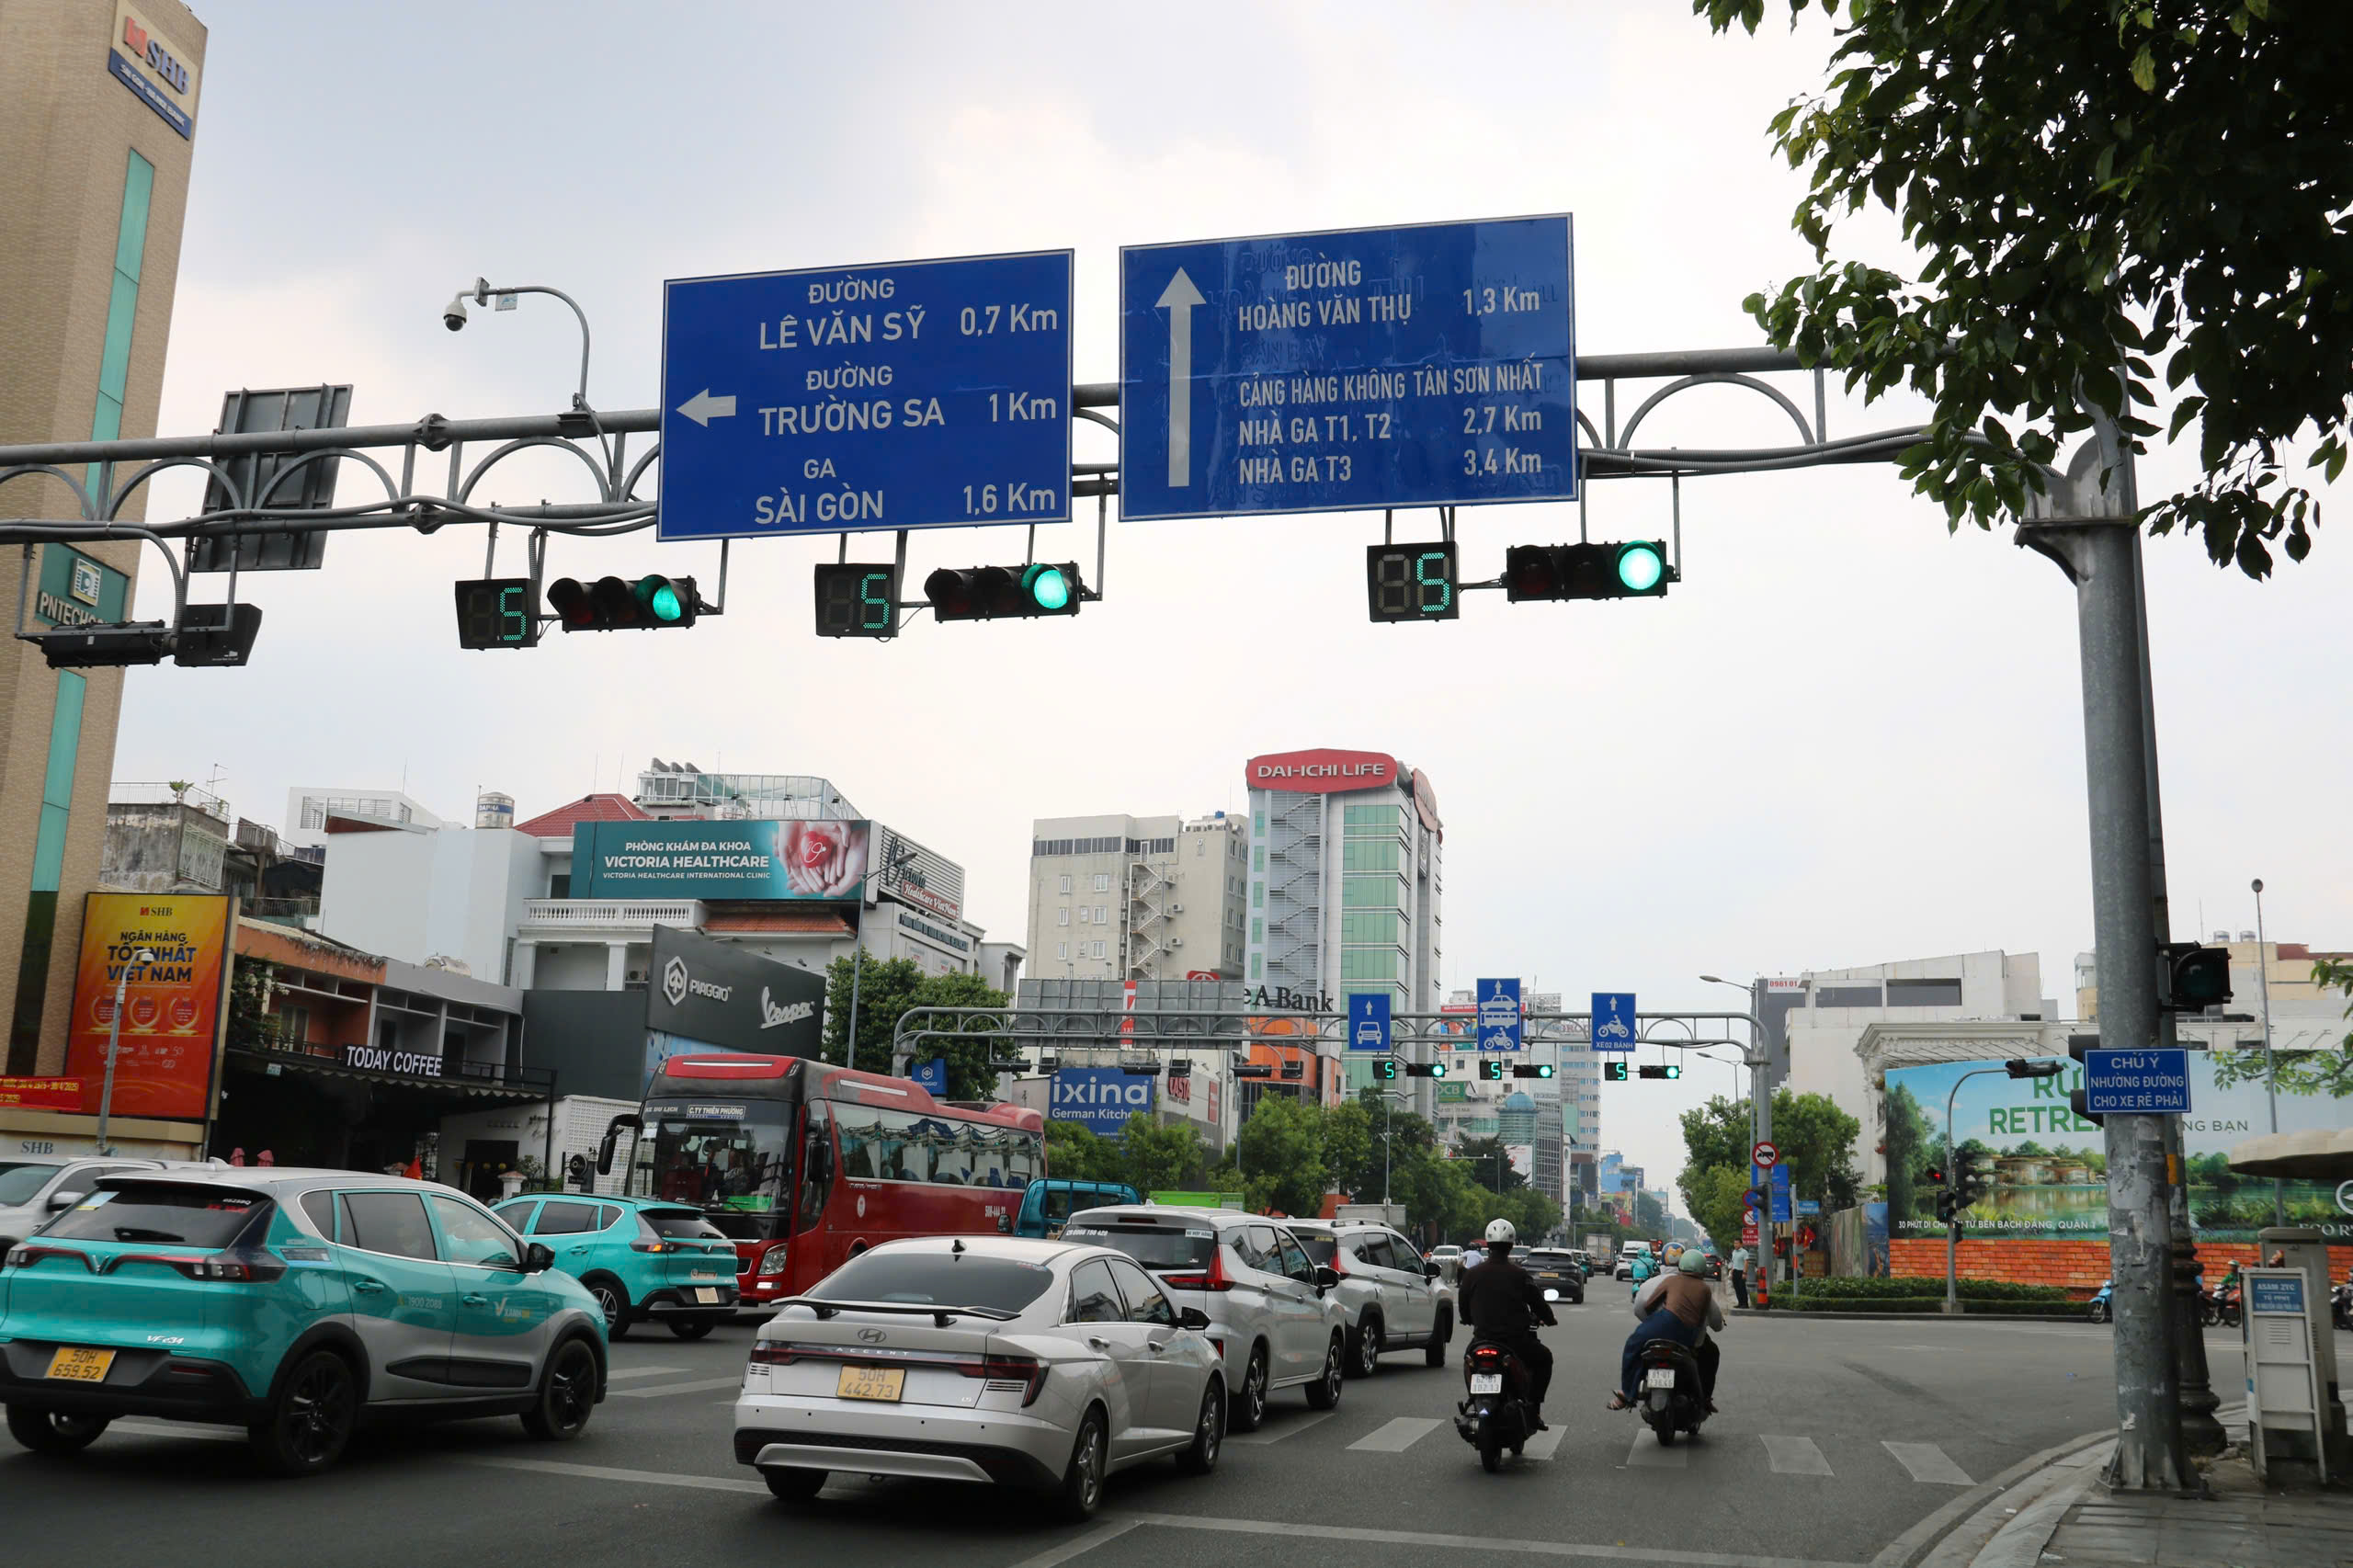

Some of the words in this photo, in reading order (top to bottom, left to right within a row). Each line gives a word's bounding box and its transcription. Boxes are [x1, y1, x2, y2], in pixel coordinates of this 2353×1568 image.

[146, 40, 190, 95] SHB
[1284, 252, 1361, 290] ĐƯỜNG
[809, 276, 894, 304] ĐƯỜNG
[1239, 296, 1311, 331] HOÀNG
[1318, 293, 1360, 325] VĂN
[1368, 293, 1412, 325] THỤ
[1463, 288, 1495, 316] 1,3
[1504, 286, 1540, 312] Km
[759, 314, 798, 349] LÊ
[807, 311, 872, 346] VĂN
[882, 305, 926, 341] SỸ
[961, 306, 1000, 336] 0,7
[1010, 303, 1058, 333] Km
[806, 361, 892, 391] ĐƯỜNG
[1240, 371, 1285, 407] CẢNG
[1291, 369, 1338, 403] HÀNG
[1344, 368, 1404, 401] KHÔNG
[1414, 364, 1448, 397] TÂN
[1453, 365, 1489, 394] SƠN
[1496, 352, 1543, 392] NHẤT
[758, 394, 892, 436] TRƯỜNG
[903, 398, 945, 427] SA
[989, 394, 998, 422] 1
[1008, 392, 1056, 420] Km
[1239, 409, 1283, 446] NHÀ
[1290, 417, 1318, 443] GA
[1325, 415, 1357, 442] T1,
[1365, 413, 1391, 439] T2
[1463, 406, 1496, 435] 2,7
[1505, 405, 1541, 432] Km
[803, 458, 836, 479] GA
[1239, 449, 1283, 484] NHÀ
[1290, 457, 1319, 483] GA
[1326, 456, 1352, 481] T3
[1464, 448, 1497, 476] 3,4
[1506, 448, 1541, 474] Km
[755, 486, 805, 524] SÀI
[817, 483, 883, 521] GÒN
[963, 485, 997, 516] 1,6
[1008, 483, 1055, 512] Km
[1417, 552, 1449, 612] 5
[859, 573, 889, 631] 5
[499, 585, 527, 642] 5
[1257, 765, 1337, 778] DAI-ICHI
[1342, 764, 1385, 777] LIFE
[624, 839, 664, 851] PHÒNG
[665, 839, 699, 851] KHÁM
[700, 841, 717, 851] ĐA
[719, 841, 751, 851] KHOA
[605, 856, 670, 868] VICTORIA
[673, 856, 769, 868] HEALTHCARE
[151, 907, 173, 916] SHB
[120, 930, 153, 942] NGÂN
[154, 930, 187, 942] HÀNG
[108, 942, 144, 961] TỐT
[107, 965, 146, 984] VIỆT
[151, 966, 192, 983] NAM
[689, 979, 729, 1002] PIAGGIO
[760, 986, 814, 1029] Vespa
[347, 1045, 392, 1071] TODAY
[393, 1051, 443, 1077] COFFEE
[1383, 1062, 1394, 1079] 5
[1490, 1062, 1501, 1079] 5
[2149, 1052, 2160, 1069] Ý
[1615, 1062, 1626, 1081] 5
[2090, 1072, 2140, 1088] NHƯỜNG
[2143, 1072, 2184, 1088] ĐƯỜNG
[1053, 1075, 1148, 1105] ixina
[2094, 1095, 2117, 1108] CHO
[2120, 1095, 2135, 1108] XE
[2137, 1091, 2153, 1107] RẼ
[2155, 1090, 2183, 1107] PHẢI
[1051, 1108, 1096, 1119] German
[1990, 1105, 2104, 1134] RETRE
[2213, 1120, 2249, 1134] BẠN
[21, 1141, 53, 1154] SHB
[1906, 1220, 1923, 1229] PHÚT
[1997, 1220, 2022, 1231] BẠCH
[72, 1349, 97, 1364] 50H
[836, 1347, 910, 1356] ACCENT
[845, 1382, 894, 1398] 442.73
